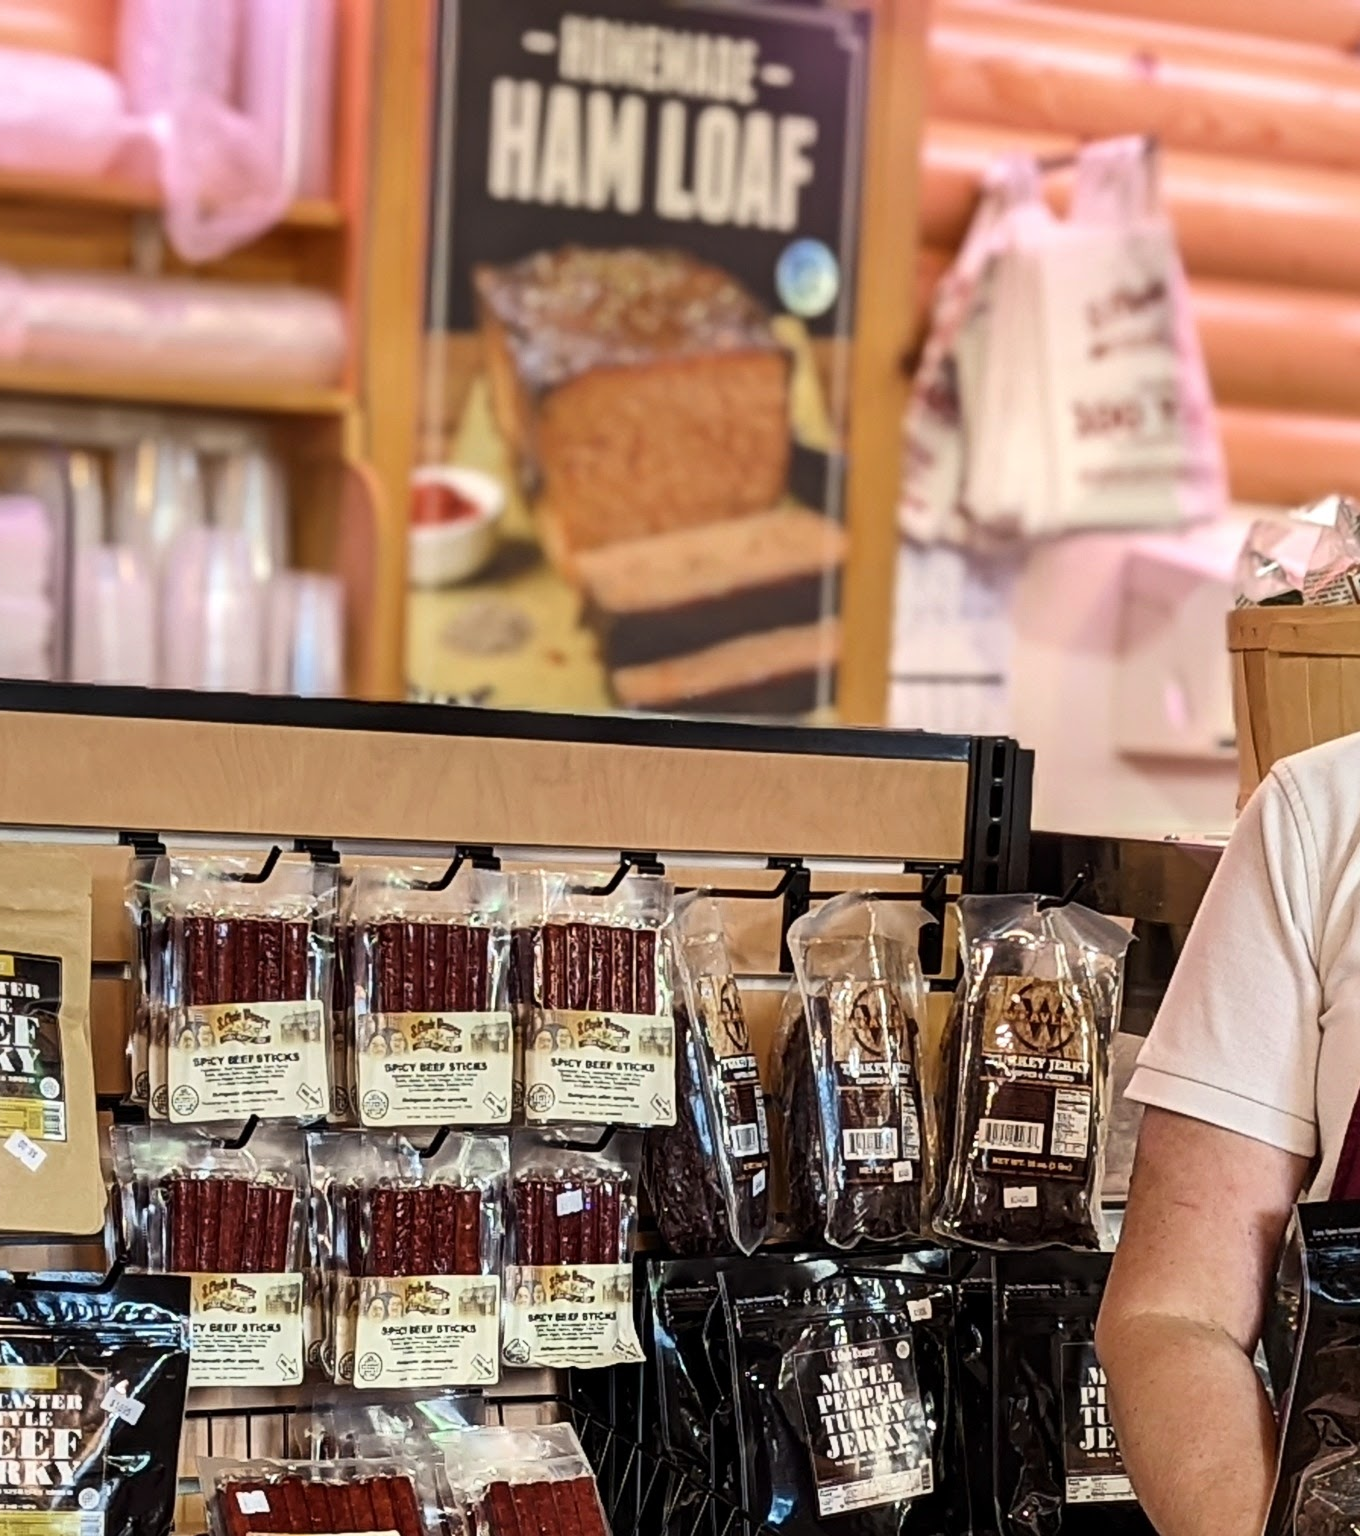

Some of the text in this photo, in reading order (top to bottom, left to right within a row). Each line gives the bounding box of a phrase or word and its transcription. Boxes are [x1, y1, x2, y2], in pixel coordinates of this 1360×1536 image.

[558, 12, 758, 105] HOMEMADE
[487, 76, 818, 232] HAM LOAF
[193, 1052, 300, 1067] SPICY BEEF STICKS
[385, 1061, 488, 1073] SPICY BEEF STICKS
[551, 1058, 655, 1072] SPICY BEEF STICKS
[1047, 1057, 1091, 1075] JERKY
[819, 1363, 895, 1394] MAPLE
[816, 1382, 905, 1415] PEPPER
[821, 1400, 907, 1434] TURKEY
[827, 1421, 911, 1459] JERKY
